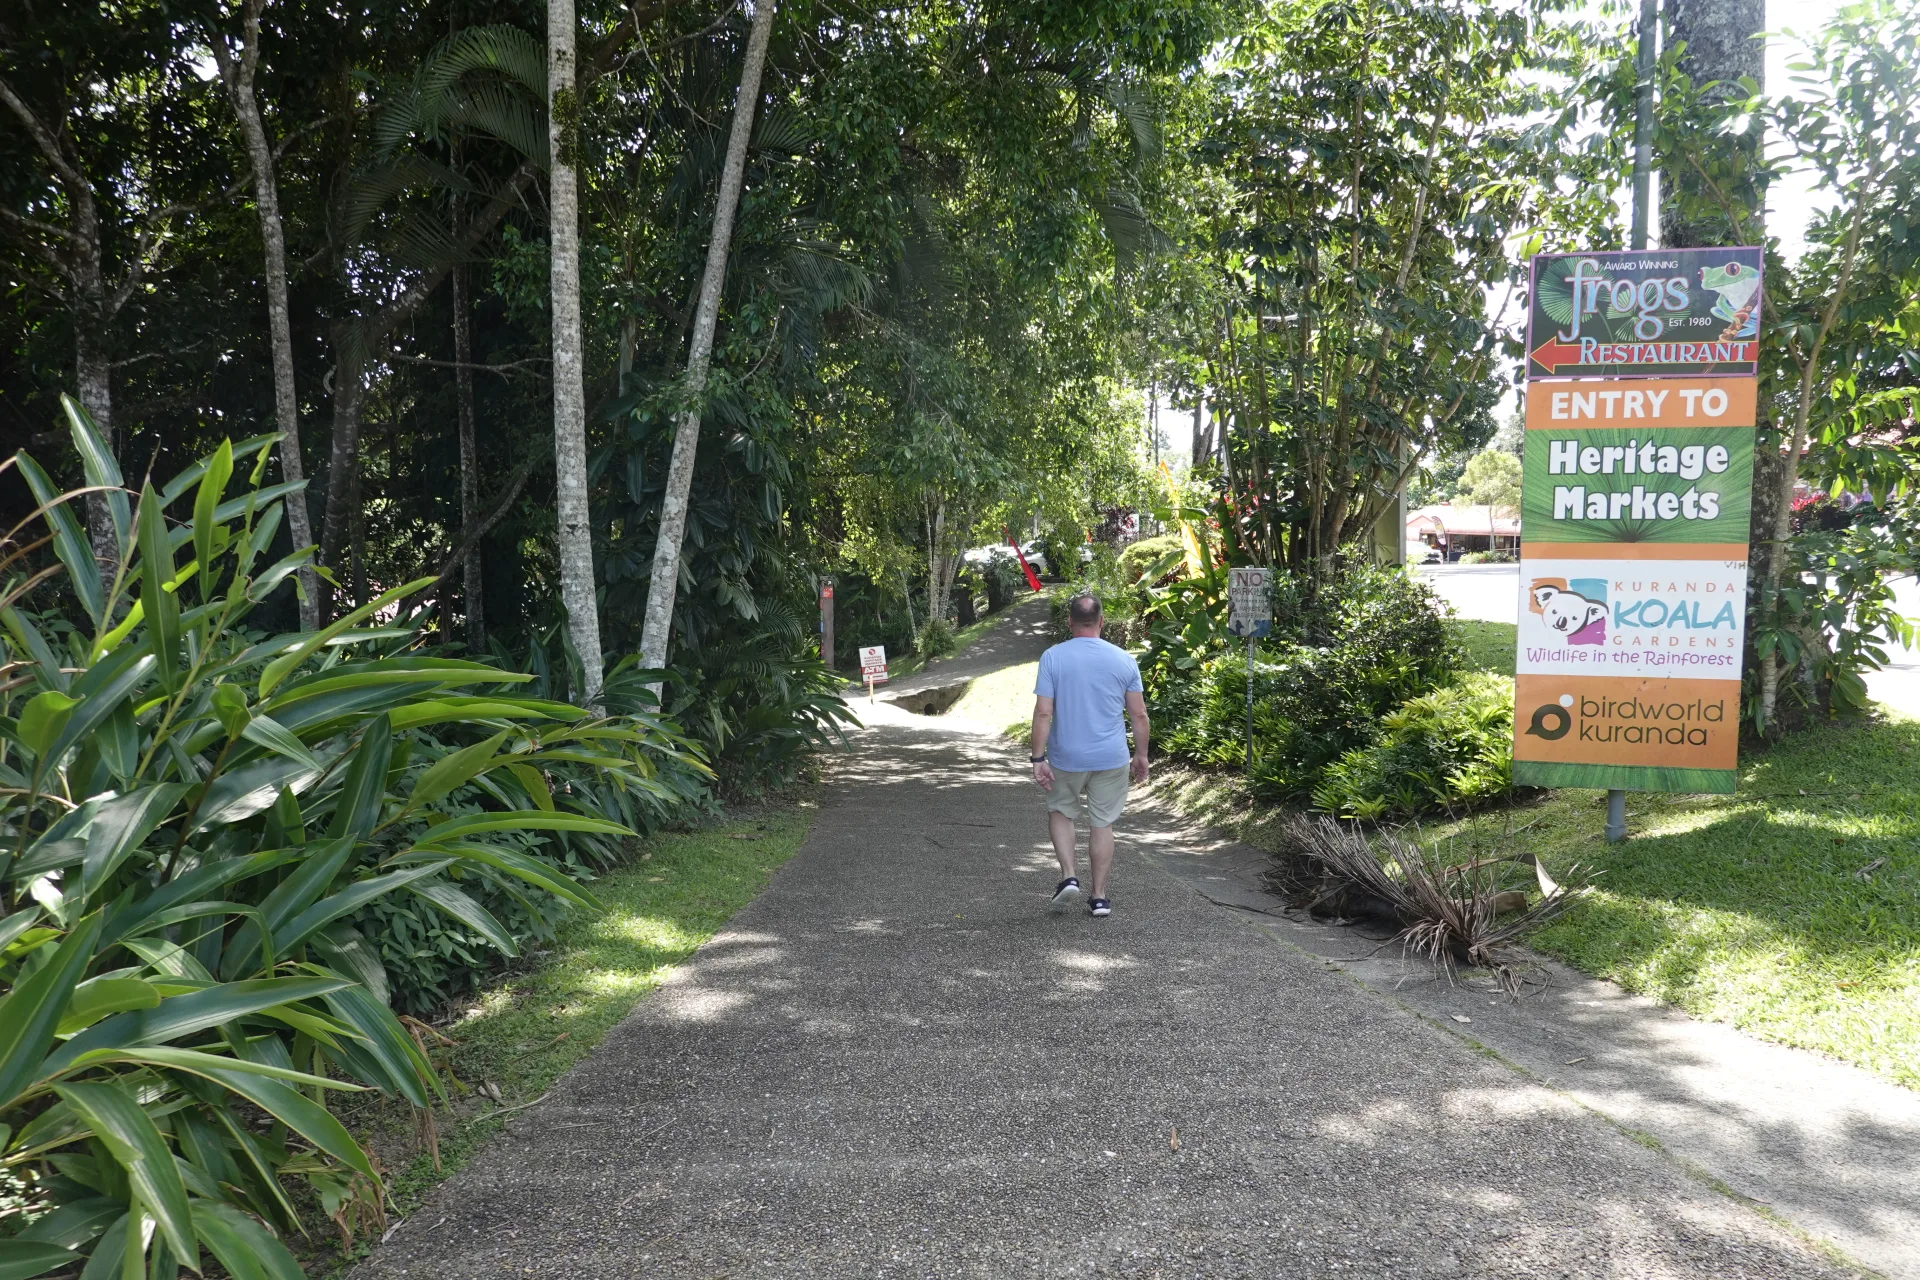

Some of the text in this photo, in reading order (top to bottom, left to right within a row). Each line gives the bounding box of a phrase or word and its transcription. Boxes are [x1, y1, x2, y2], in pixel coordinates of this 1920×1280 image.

[1604, 260, 1678, 271] AWARD WINNING
[1558, 258, 1689, 342] frogs
[1689, 317, 1712, 327] 1980
[1579, 337, 1748, 365] RESTAURANT
[1551, 388, 1728, 420] ENTRY TO
[1548, 437, 1729, 481] Heritage
[1553, 483, 1720, 520] Markets
[1237, 573, 1263, 586] NO
[1615, 581, 1735, 593] KURANDA
[1613, 599, 1737, 630] KOALA
[1612, 635, 1735, 648] GARDENS
[1526, 647, 1734, 666] Wildlife in the Rainforest
[1580, 695, 1724, 722] birdworld
[1579, 720, 1708, 746] kuranda
